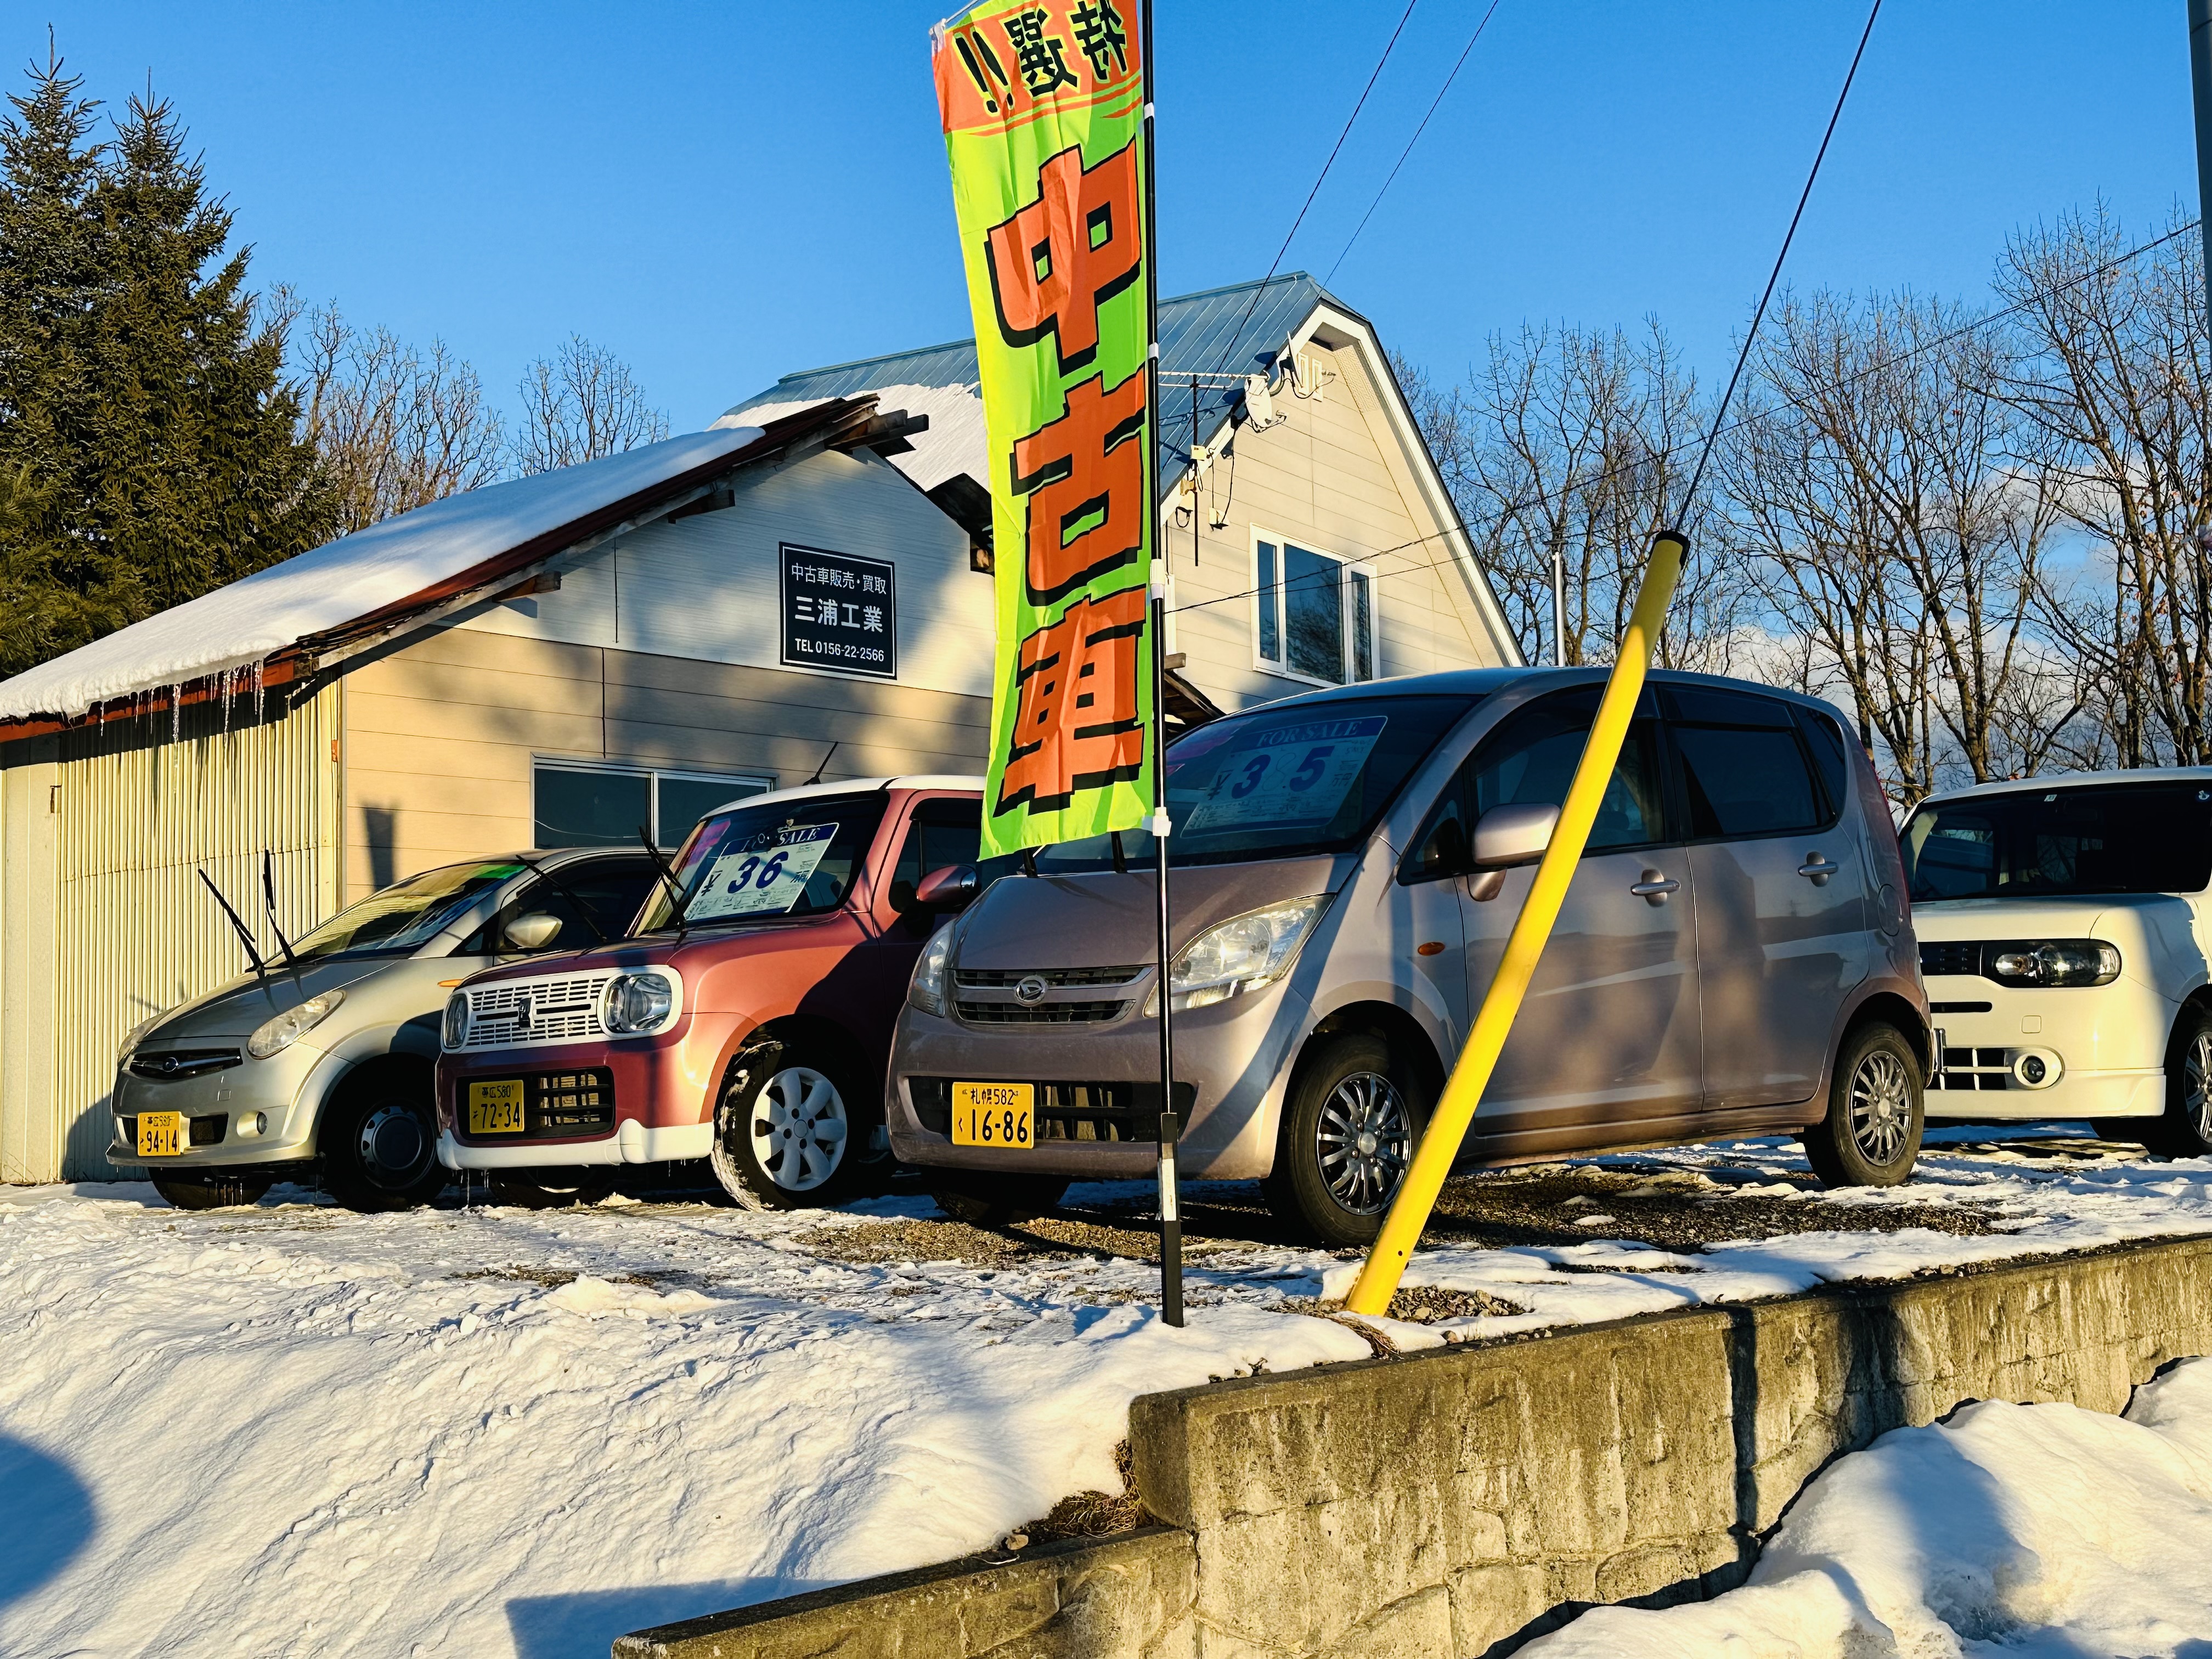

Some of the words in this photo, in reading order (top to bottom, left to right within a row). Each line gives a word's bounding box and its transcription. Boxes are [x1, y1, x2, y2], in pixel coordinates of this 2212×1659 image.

[792, 563, 886, 594] 中古車販売・買取
[795, 596, 883, 633] 三浦工業
[795, 639, 813, 653] TEL
[816, 641, 884, 662] 0156-22-2566
[1256, 728, 1300, 747] FOR
[1301, 721, 1362, 741] SALE
[777, 827, 820, 845] SALE
[727, 851, 789, 894] 36
[972, 1109, 1028, 1143] 16-86
